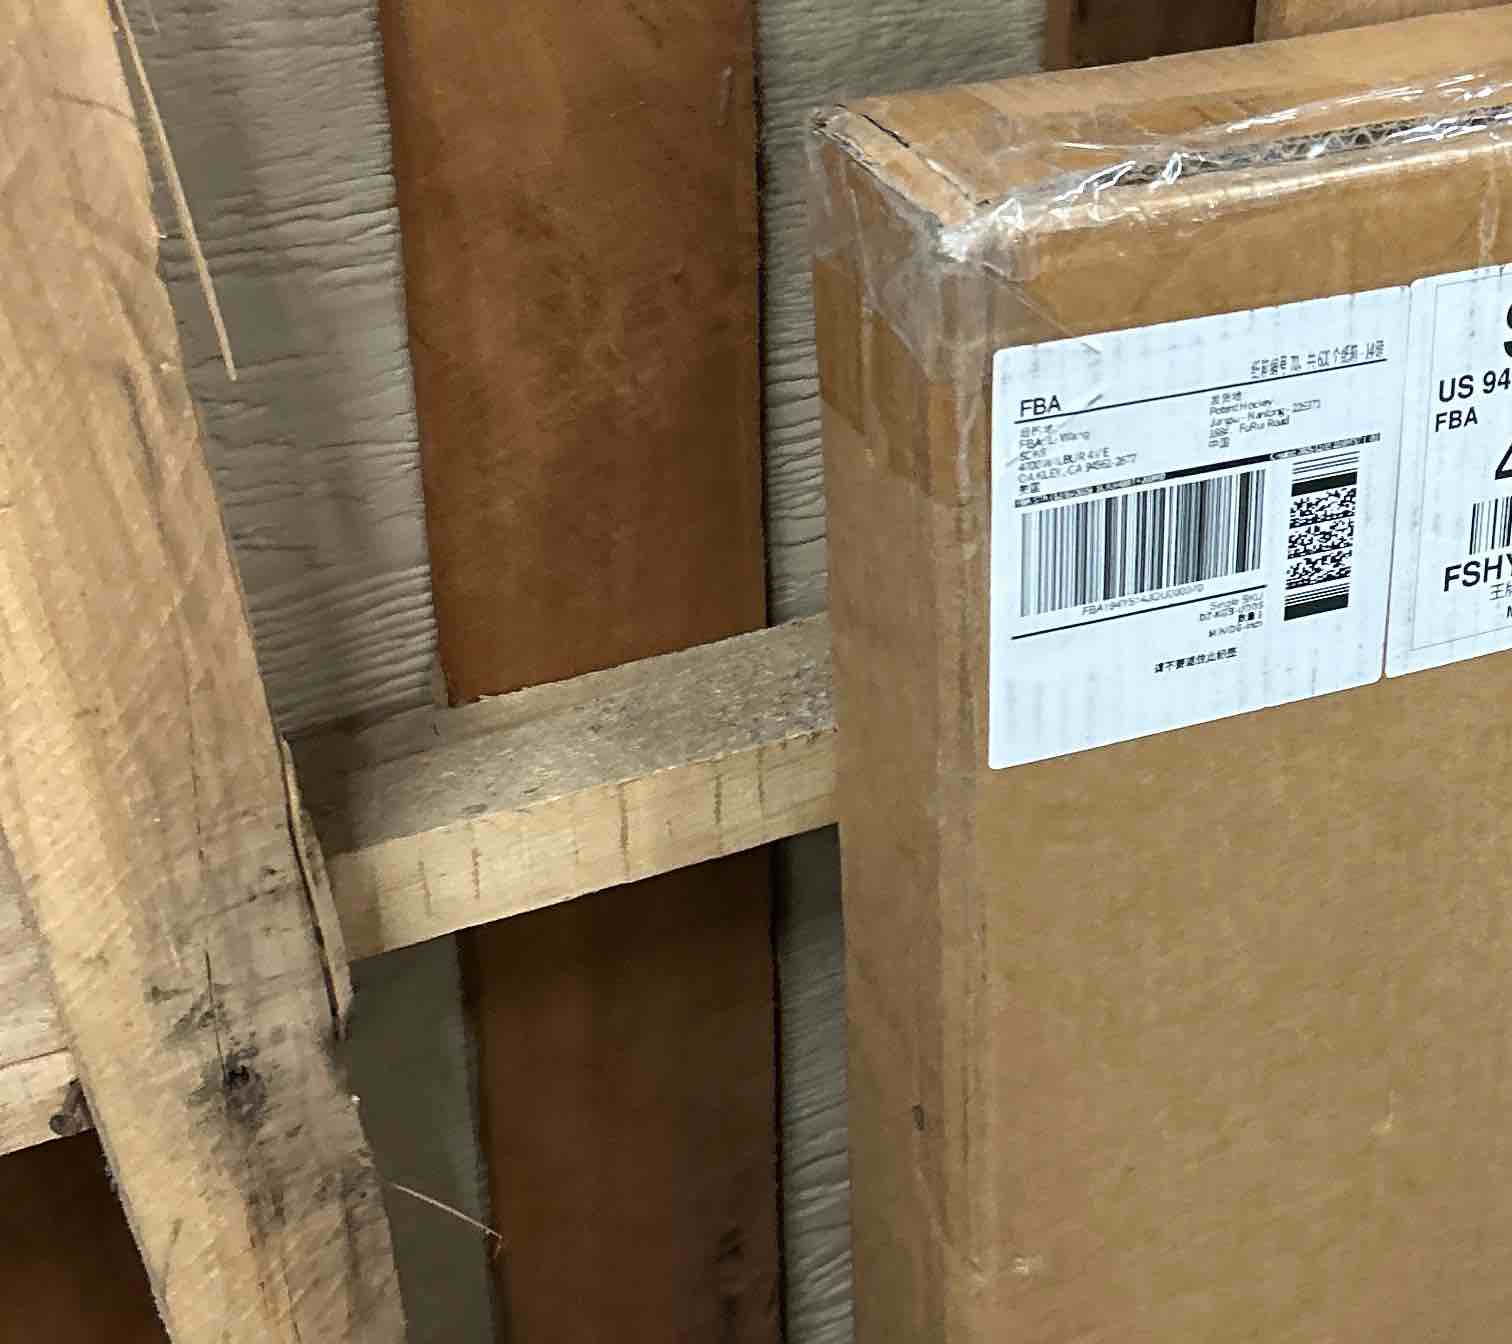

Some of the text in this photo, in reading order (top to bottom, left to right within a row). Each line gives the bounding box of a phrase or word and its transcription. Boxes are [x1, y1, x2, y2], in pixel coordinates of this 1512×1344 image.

[1438, 374, 1474, 403] US
[1020, 394, 1062, 417] FBA
[1435, 406, 1478, 433] FBA
